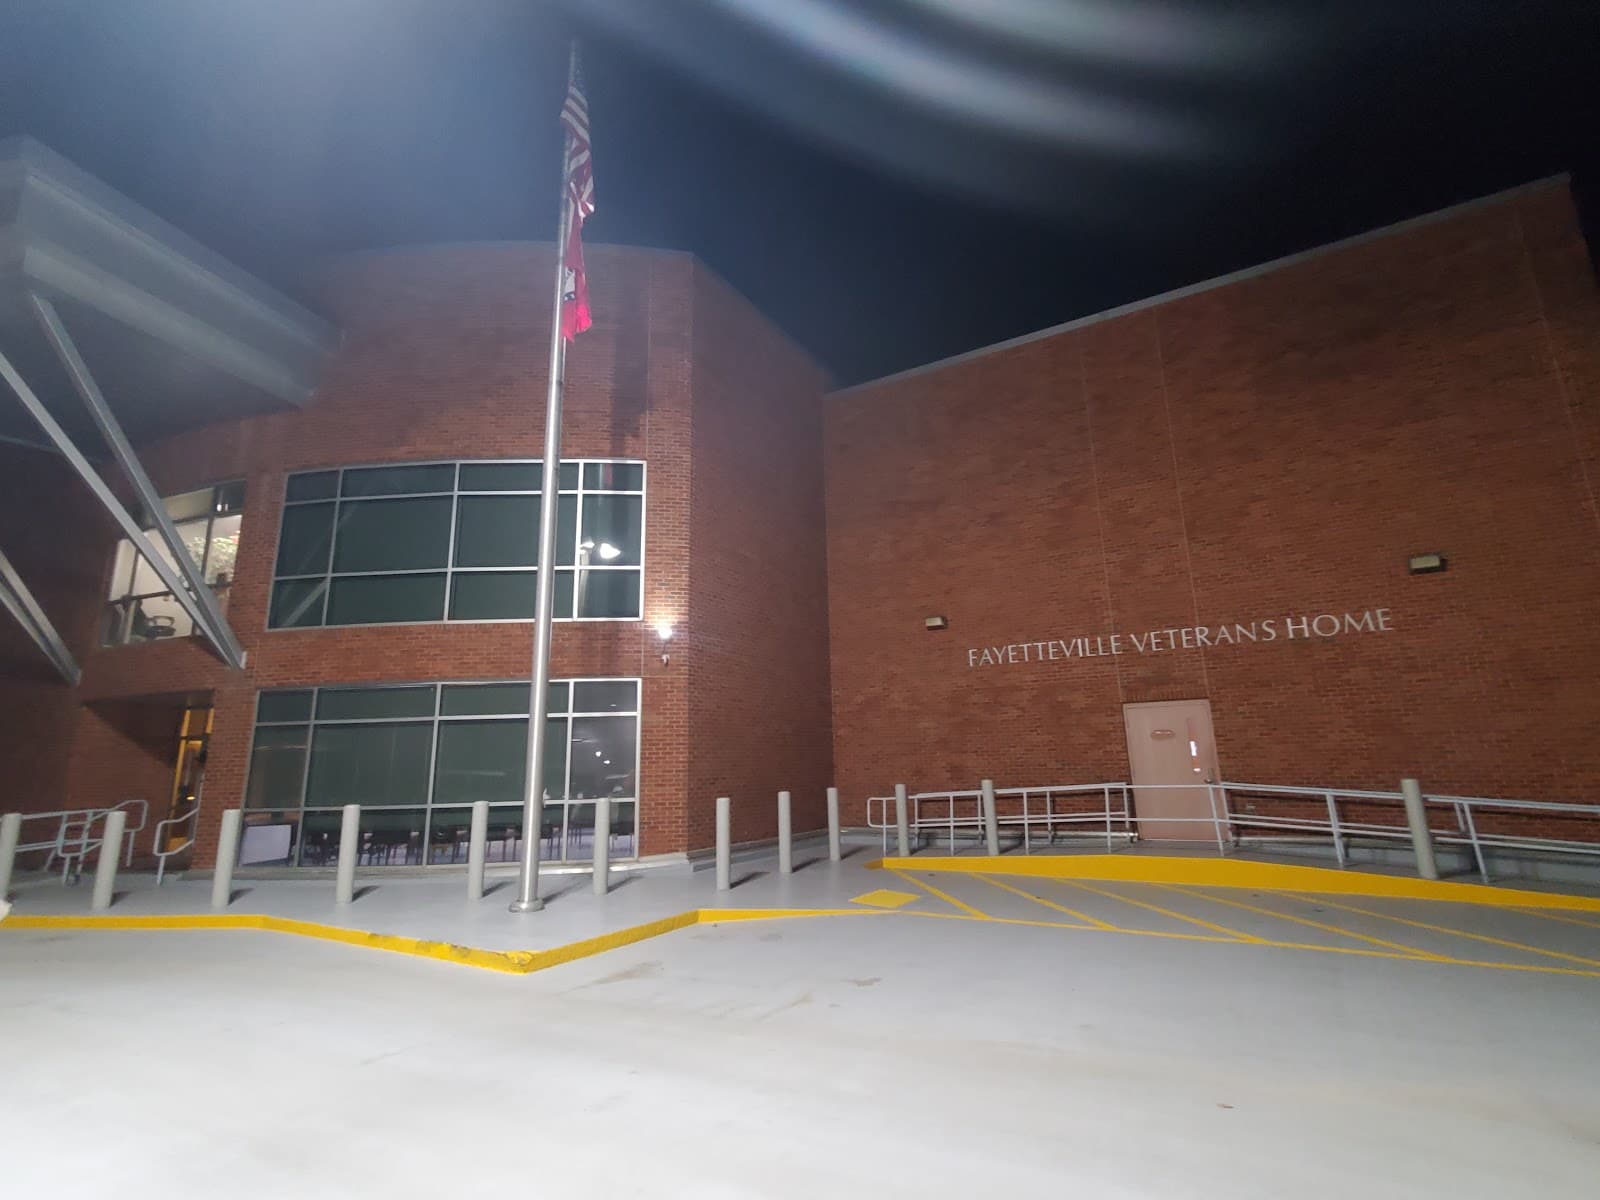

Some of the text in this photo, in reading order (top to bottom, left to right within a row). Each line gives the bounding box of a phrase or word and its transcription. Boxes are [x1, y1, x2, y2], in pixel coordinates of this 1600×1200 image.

[968, 608, 1394, 667] FAYETTEVILLE VETERANS HOME
